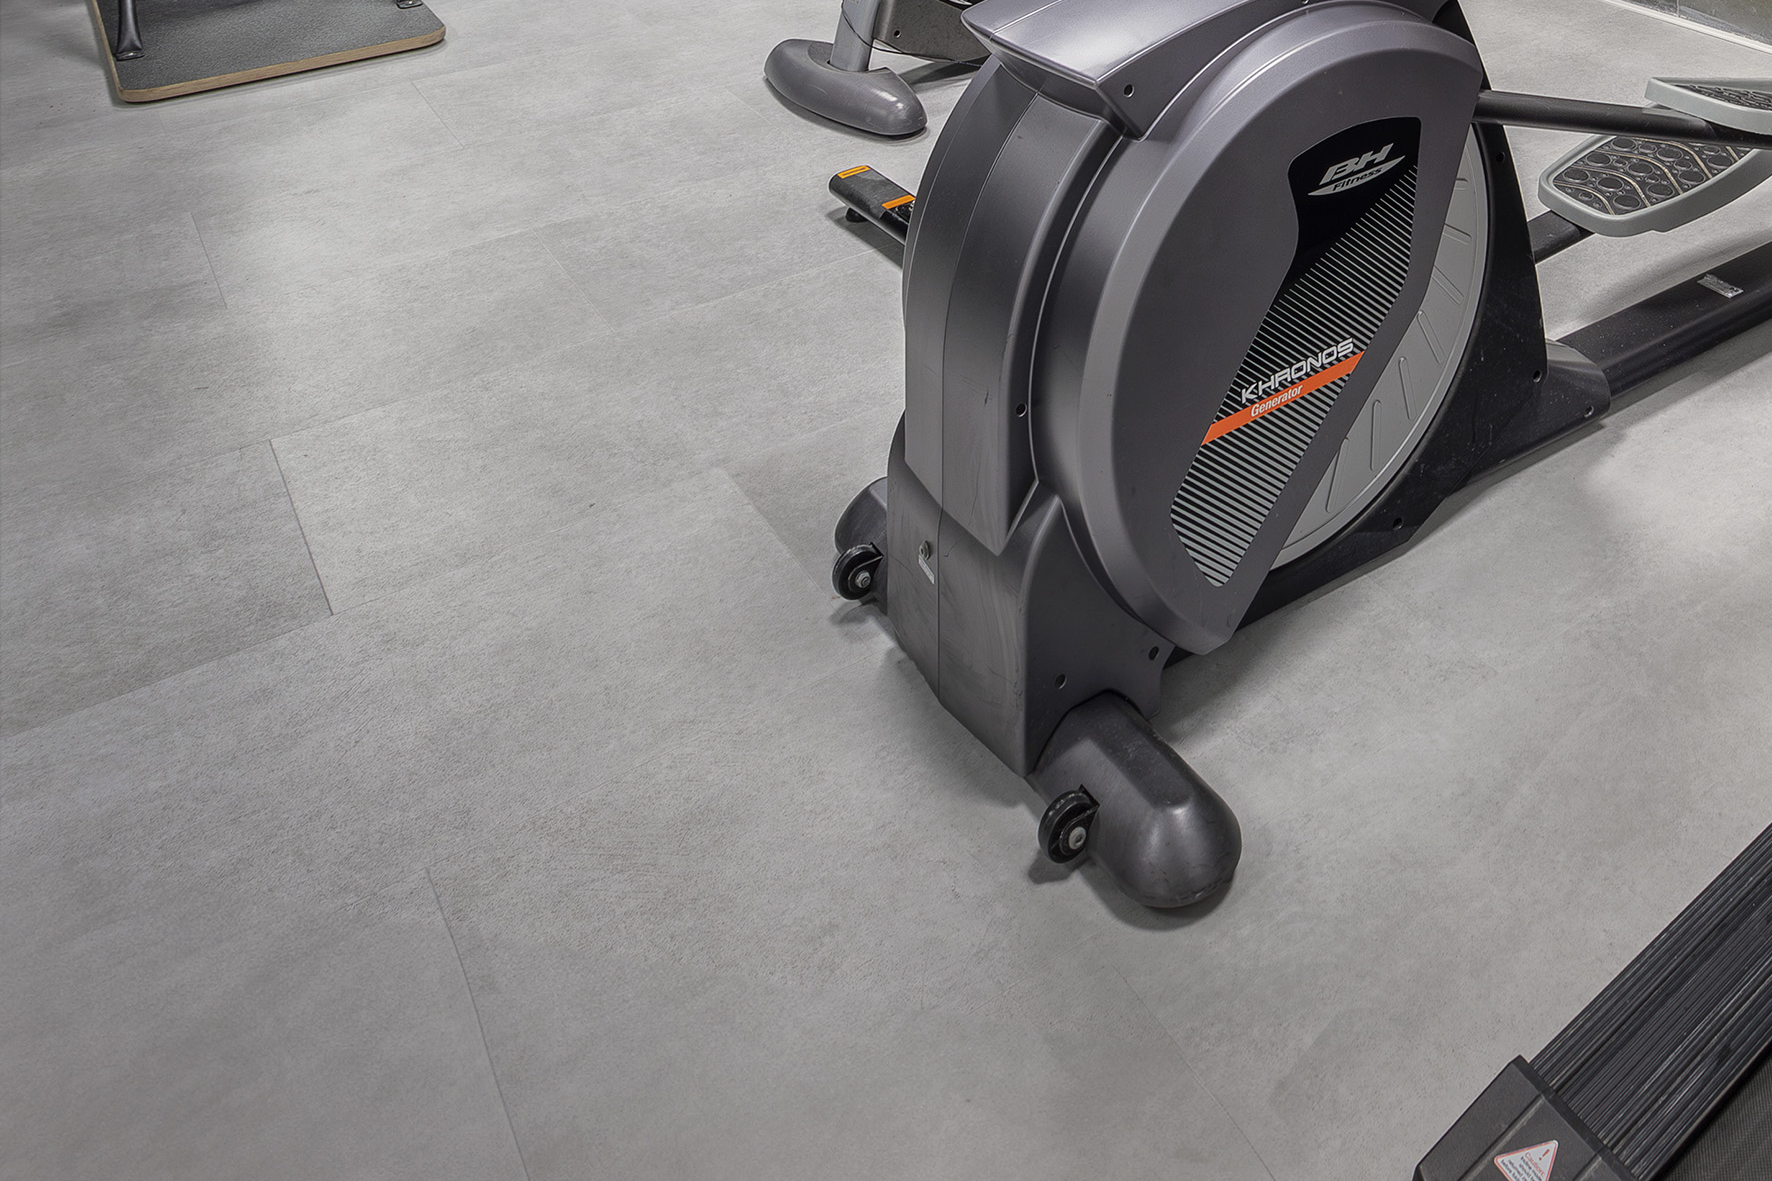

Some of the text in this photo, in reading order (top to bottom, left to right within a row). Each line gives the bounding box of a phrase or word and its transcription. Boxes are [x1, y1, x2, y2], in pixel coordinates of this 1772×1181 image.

[1319, 142, 1394, 186] BH
[1332, 166, 1384, 192] Fitness
[1241, 337, 1354, 405] KHRONOS
[1250, 384, 1304, 418] Generator
